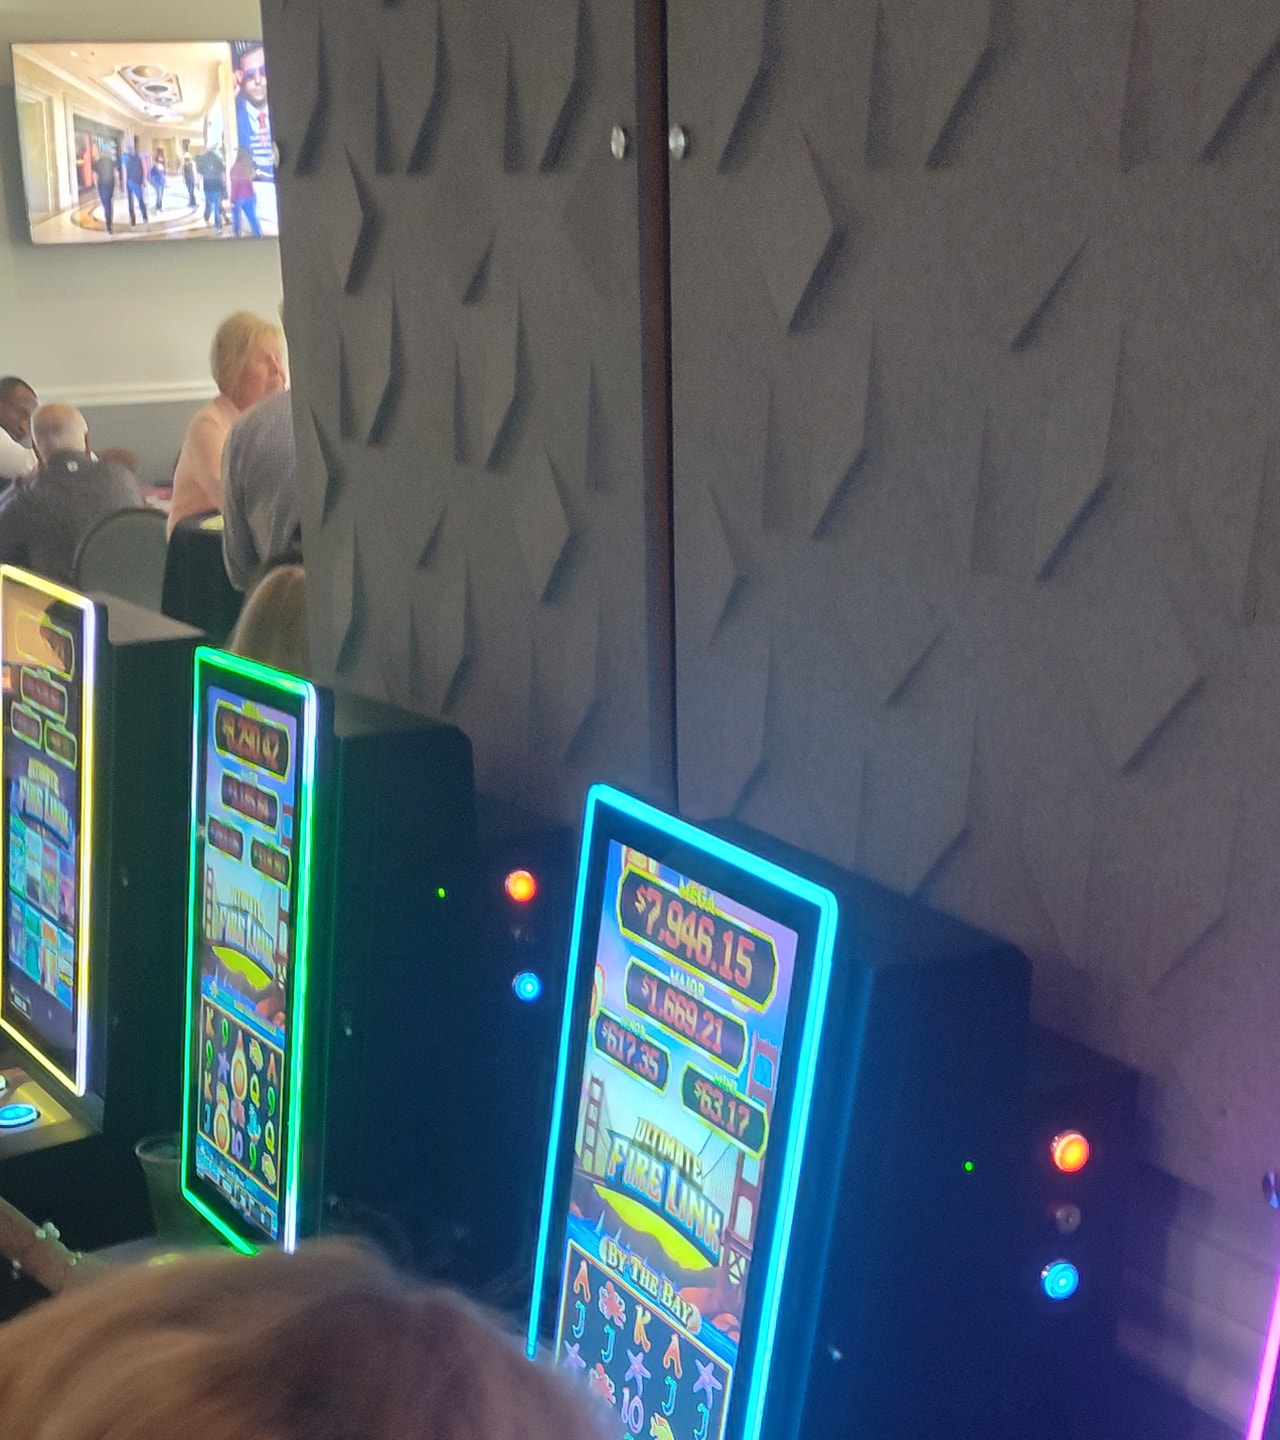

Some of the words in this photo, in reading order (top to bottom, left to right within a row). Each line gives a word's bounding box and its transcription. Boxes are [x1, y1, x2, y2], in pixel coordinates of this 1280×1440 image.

[678, 875, 716, 915] MEGA
[670, 968, 705, 1000] MAJOR
[694, 1079, 750, 1136] $63.17
[635, 1117, 702, 1186] ULTIMATE
[608, 1136, 663, 1200] FIRE
[666, 1166, 720, 1253] LINK
[574, 1260, 591, 1302] A
[572, 1300, 586, 1338] J
[634, 1305, 651, 1352] K
[601, 1325, 615, 1363] J
[663, 1333, 682, 1379] A
[621, 1387, 644, 1434] 10
[662, 1376, 677, 1416] J
